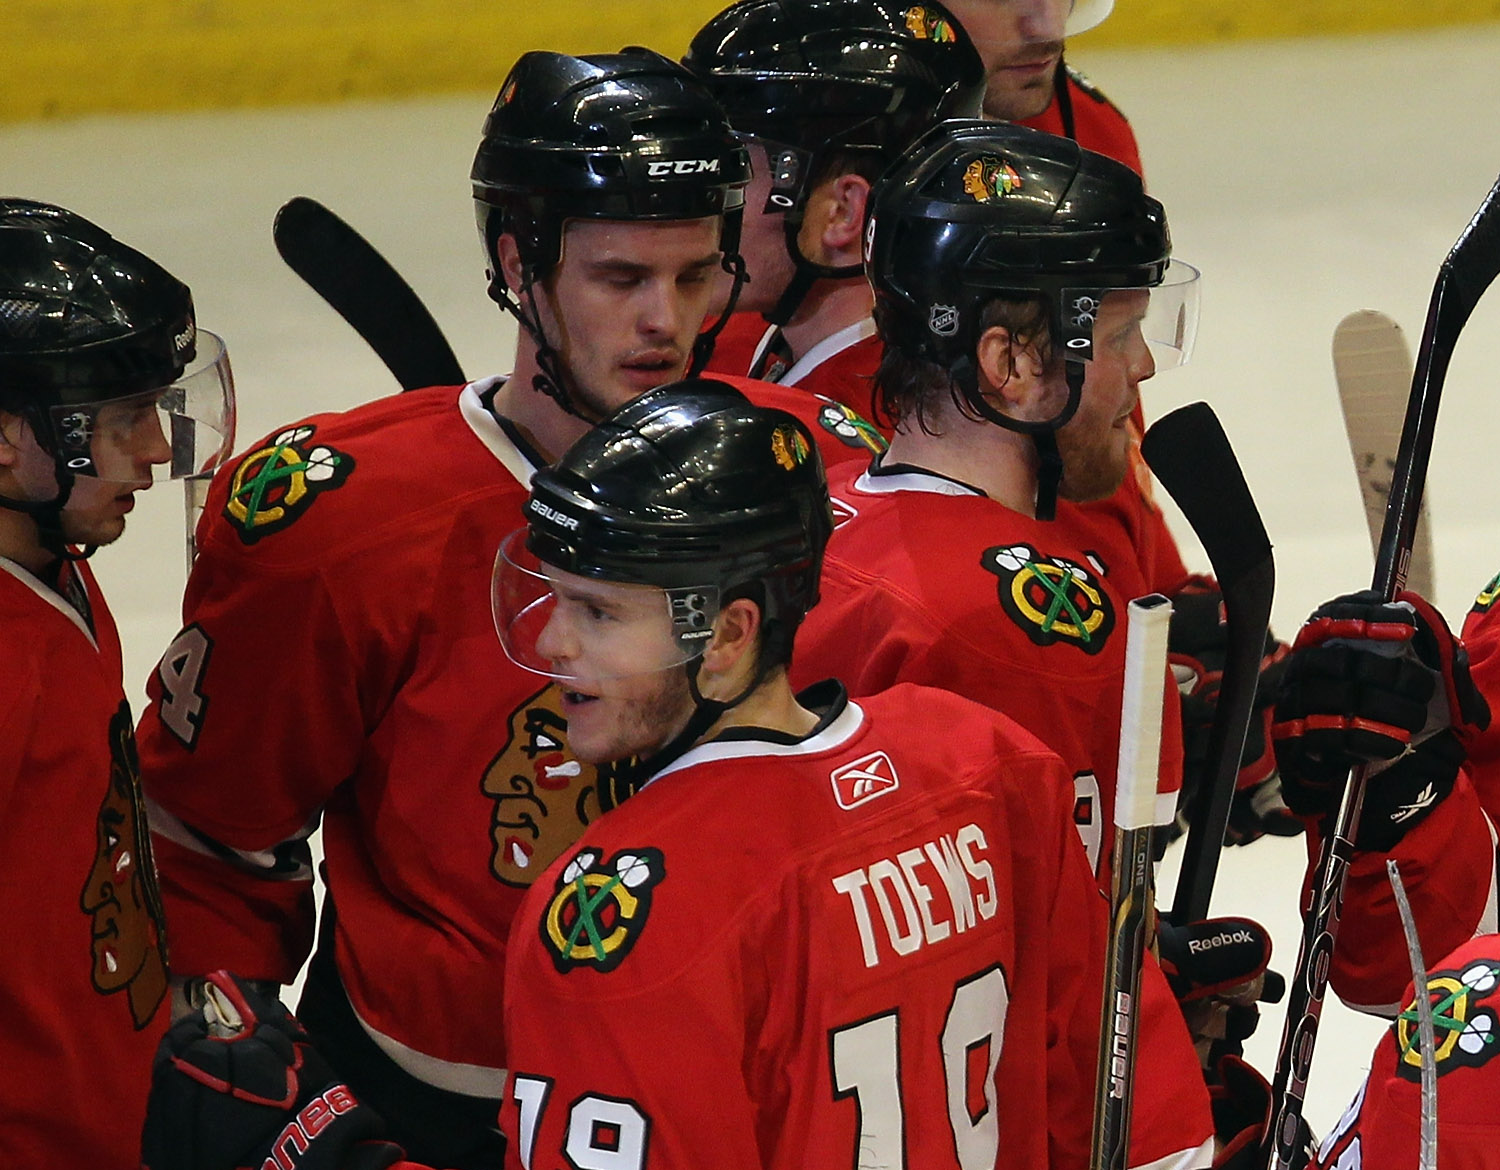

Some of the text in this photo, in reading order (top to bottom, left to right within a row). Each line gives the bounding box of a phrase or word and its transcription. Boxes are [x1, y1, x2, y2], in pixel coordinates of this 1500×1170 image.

[647, 158, 720, 176] CCM
[529, 498, 579, 532] BAUER
[831, 822, 998, 969] TOEWS
[1187, 929, 1255, 955] Reebok
[1109, 990, 1131, 1100] BAUER
